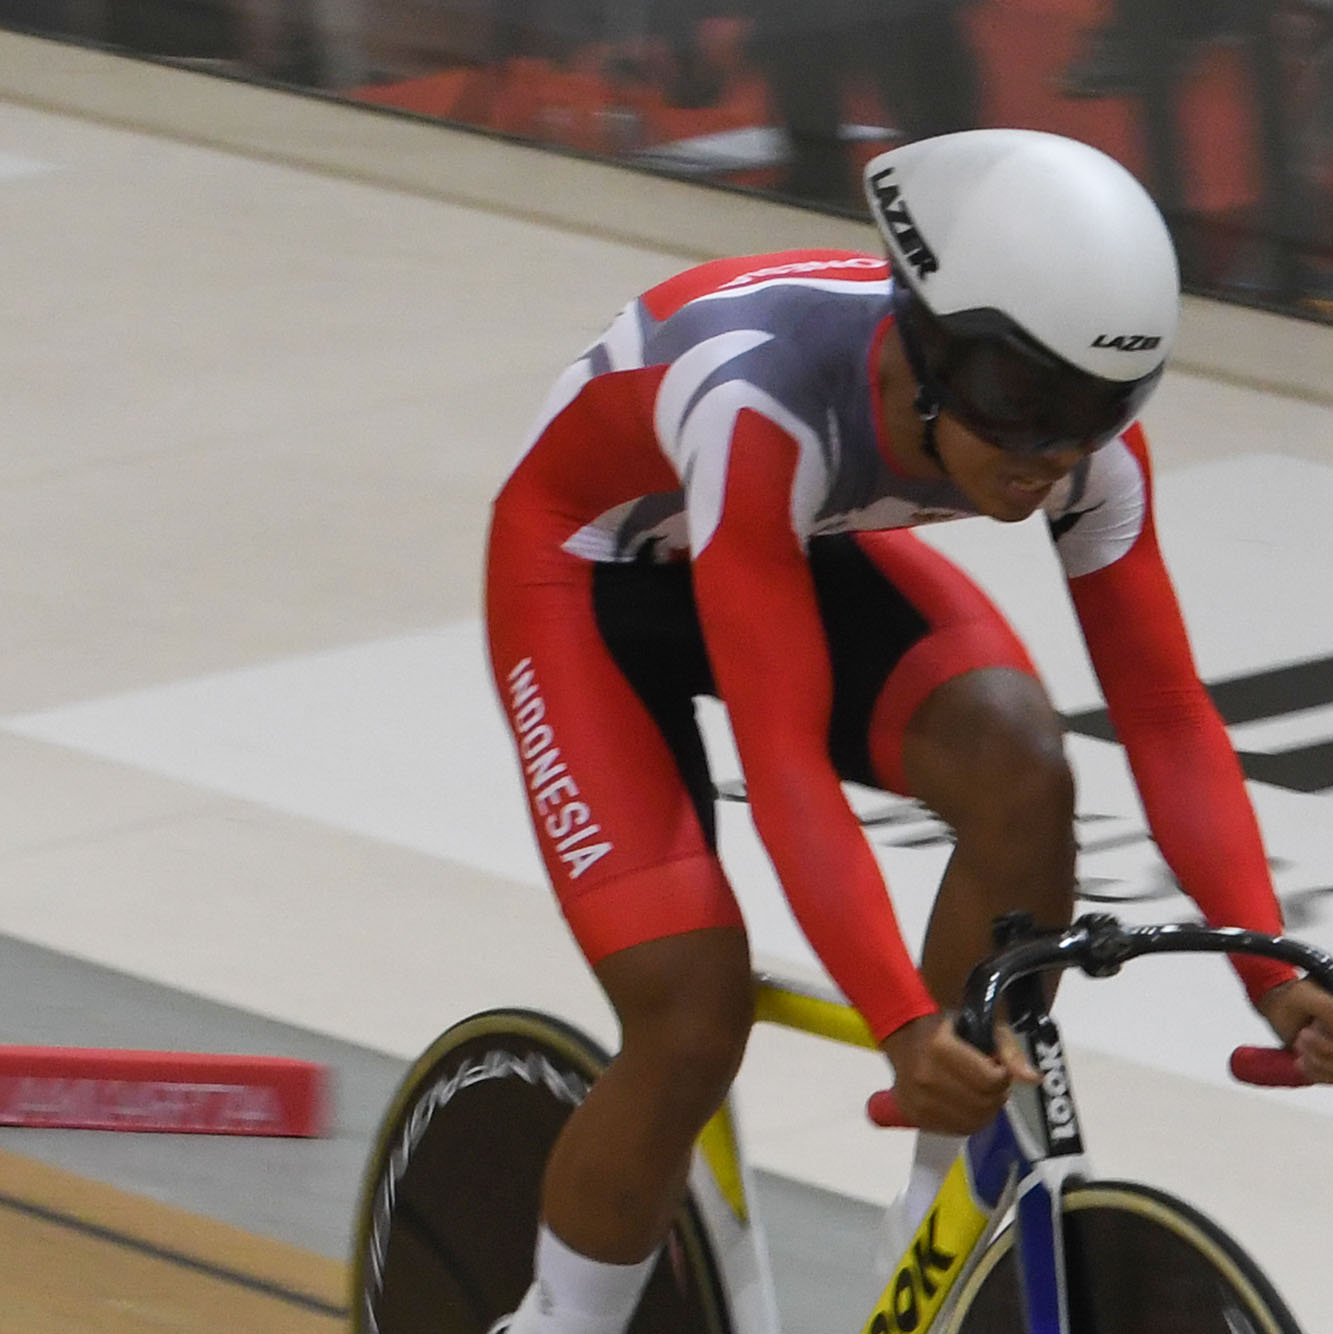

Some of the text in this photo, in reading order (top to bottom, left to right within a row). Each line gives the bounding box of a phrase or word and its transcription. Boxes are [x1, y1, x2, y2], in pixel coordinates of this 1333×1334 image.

[869, 166, 940, 281] LAZER
[507, 655, 614, 880] INDONESIA
[1034, 1039, 1077, 1141] LOOK
